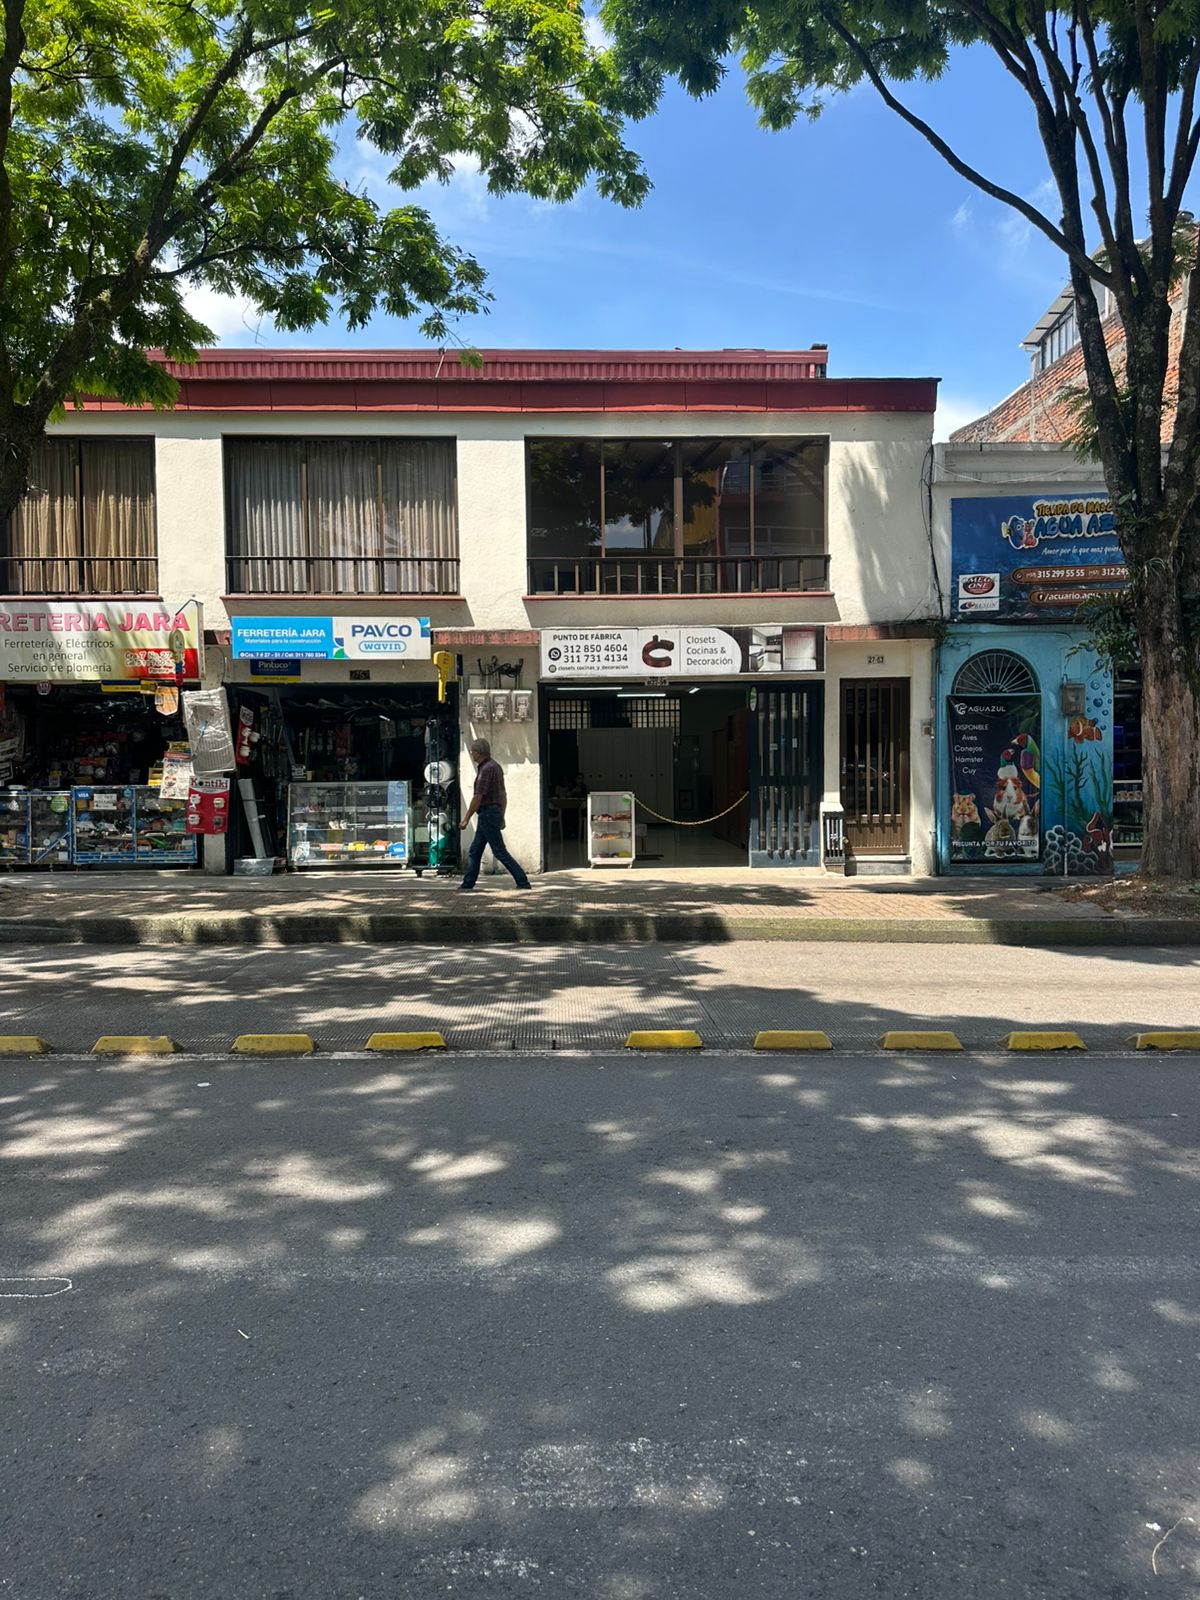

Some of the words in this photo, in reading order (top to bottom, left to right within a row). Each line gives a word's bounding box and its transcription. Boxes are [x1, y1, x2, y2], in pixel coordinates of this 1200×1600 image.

[1071, 502, 1084, 514] DE
[1034, 514, 1083, 538] AGUA
[1038, 570, 1050, 578] 315
[1066, 569, 1074, 577] 55
[1102, 568, 1115, 576] 312
[118, 613, 190, 632] JARA
[238, 627, 298, 637] FERRETERÍA
[300, 629, 326, 637] JARA
[352, 622, 412, 638] PAVCO
[4, 638, 54, 648] Ferretería
[57, 641, 62, 650] y
[66, 638, 114, 648] Eléctricos
[686, 636, 716, 644] Closets
[364, 642, 401, 651] wavin
[564, 645, 581, 653] 312
[584, 644, 601, 653] 850
[604, 644, 628, 652] 4604
[686, 647, 718, 655] Cocinas
[48, 651, 86, 662] general
[564, 655, 580, 663] 311
[584, 654, 601, 662] 731
[604, 654, 628, 662] 4134
[687, 657, 733, 666] Decoración
[8, 663, 48, 672] Servicio
[51, 663, 64, 672] de
[66, 663, 112, 674] plomería
